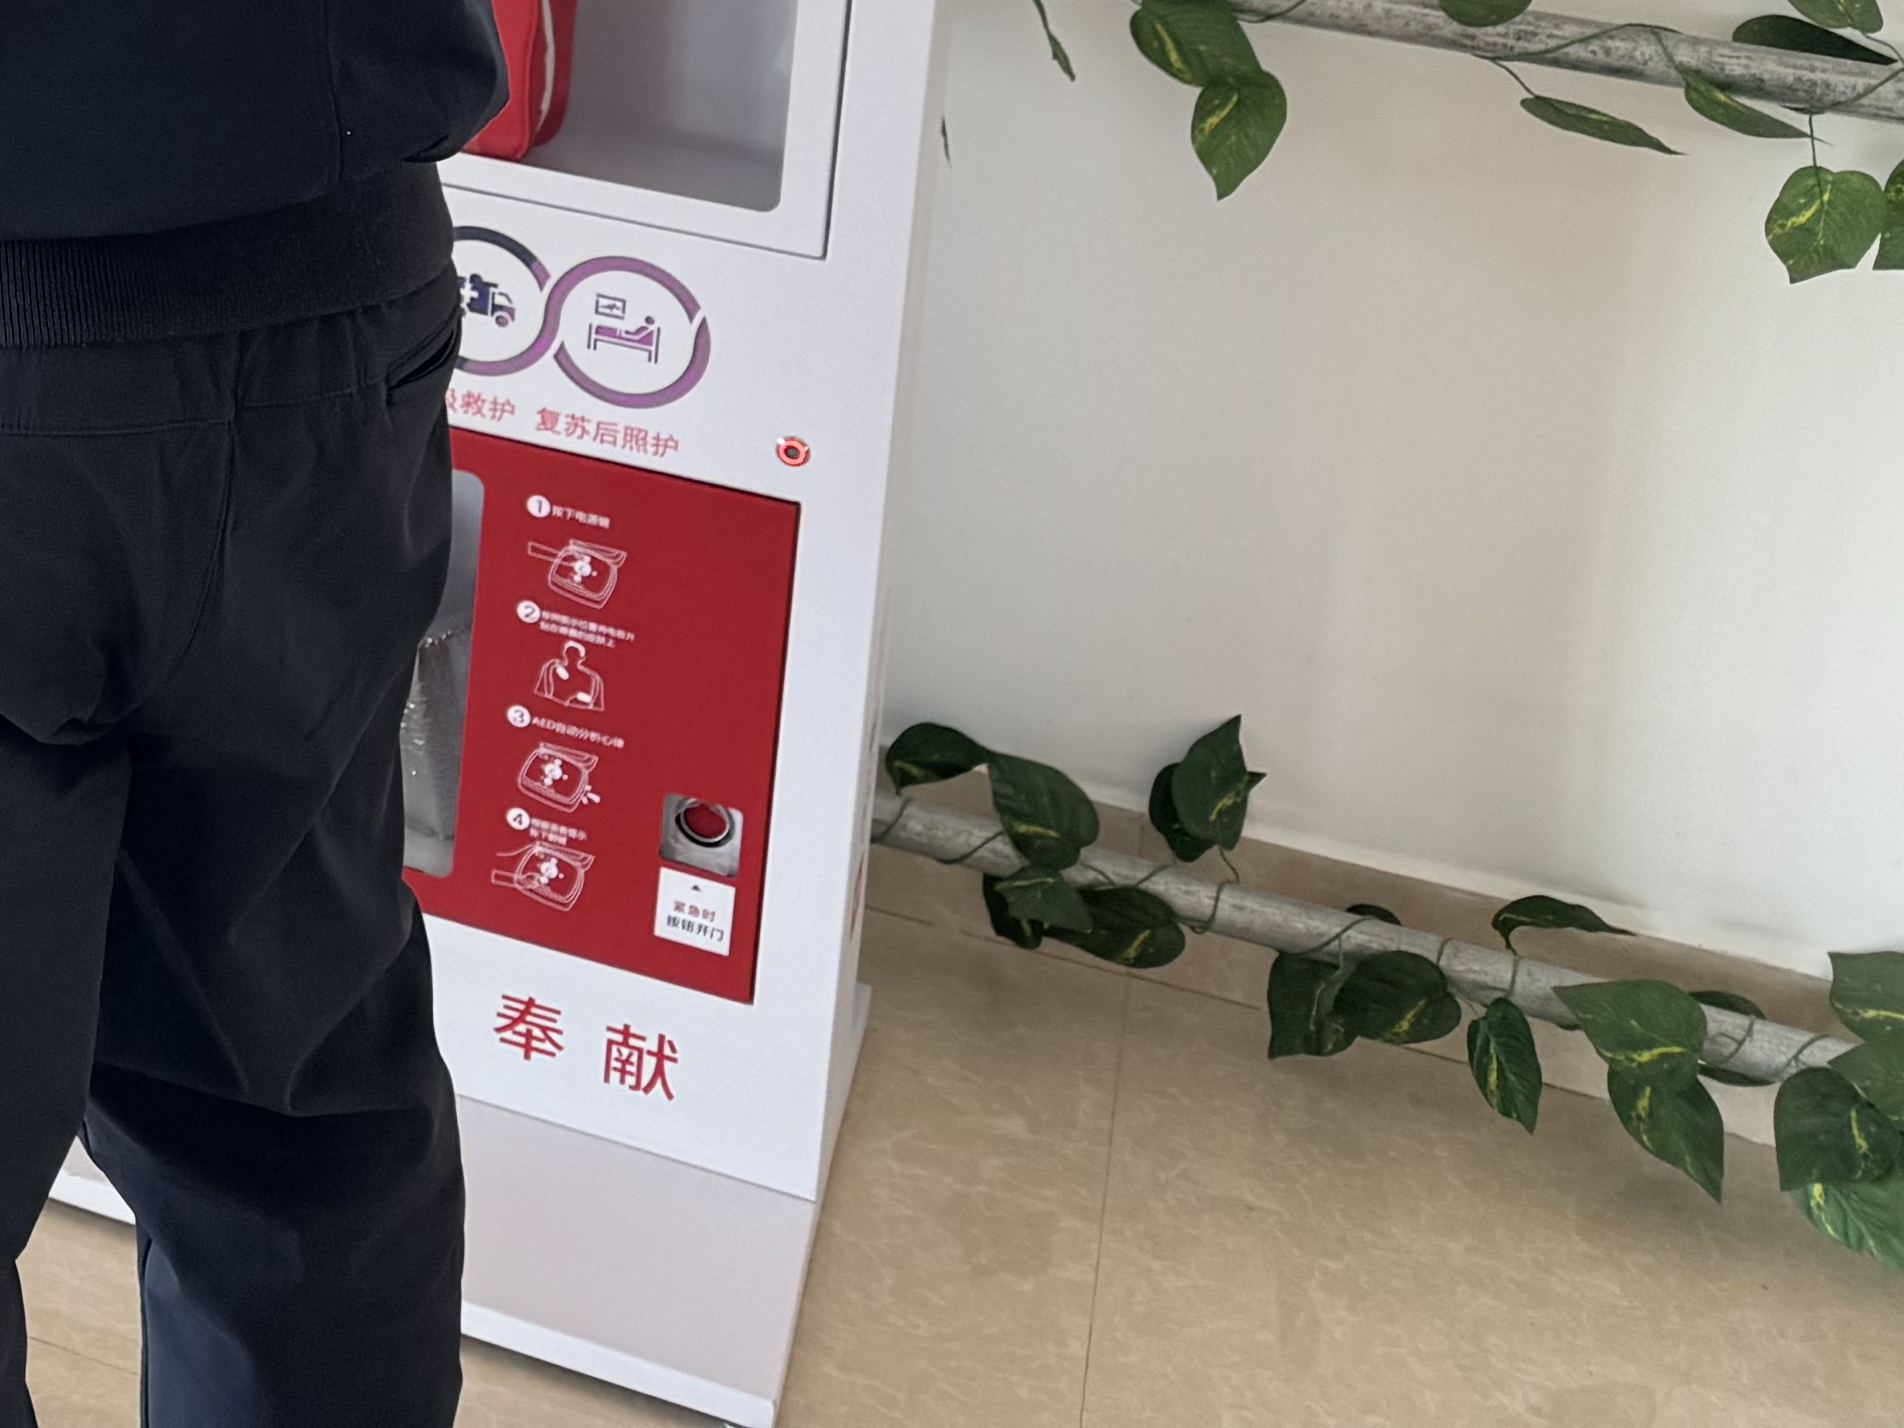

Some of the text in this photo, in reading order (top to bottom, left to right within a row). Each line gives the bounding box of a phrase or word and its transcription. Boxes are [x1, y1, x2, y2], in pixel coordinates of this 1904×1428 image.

[535, 406, 679, 458] 复苏后照护
[493, 994, 679, 1101] 奉献
